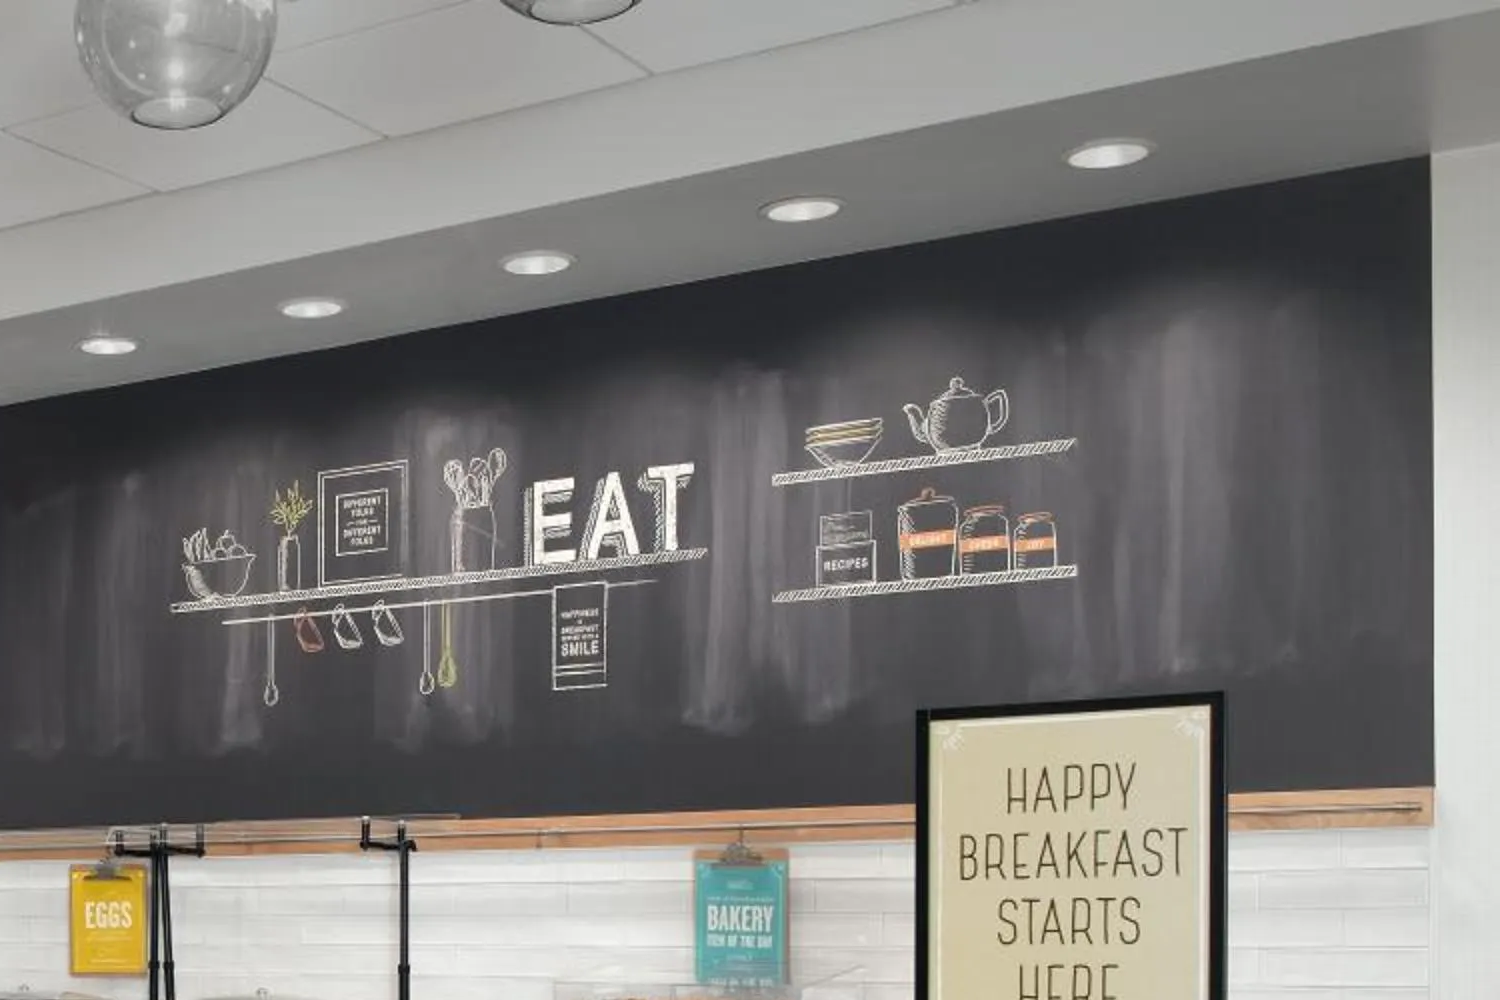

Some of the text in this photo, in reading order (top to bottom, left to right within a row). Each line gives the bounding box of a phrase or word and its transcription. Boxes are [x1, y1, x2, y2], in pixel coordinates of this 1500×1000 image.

[525, 462, 695, 568] EAT
[560, 639, 599, 657] SMILE
[1007, 762, 1136, 814] HAPPY
[959, 827, 1188, 881] BREAKFAST
[84, 901, 133, 929] EGGS
[707, 904, 773, 933] BAKERY
[997, 896, 1141, 945] STARTS
